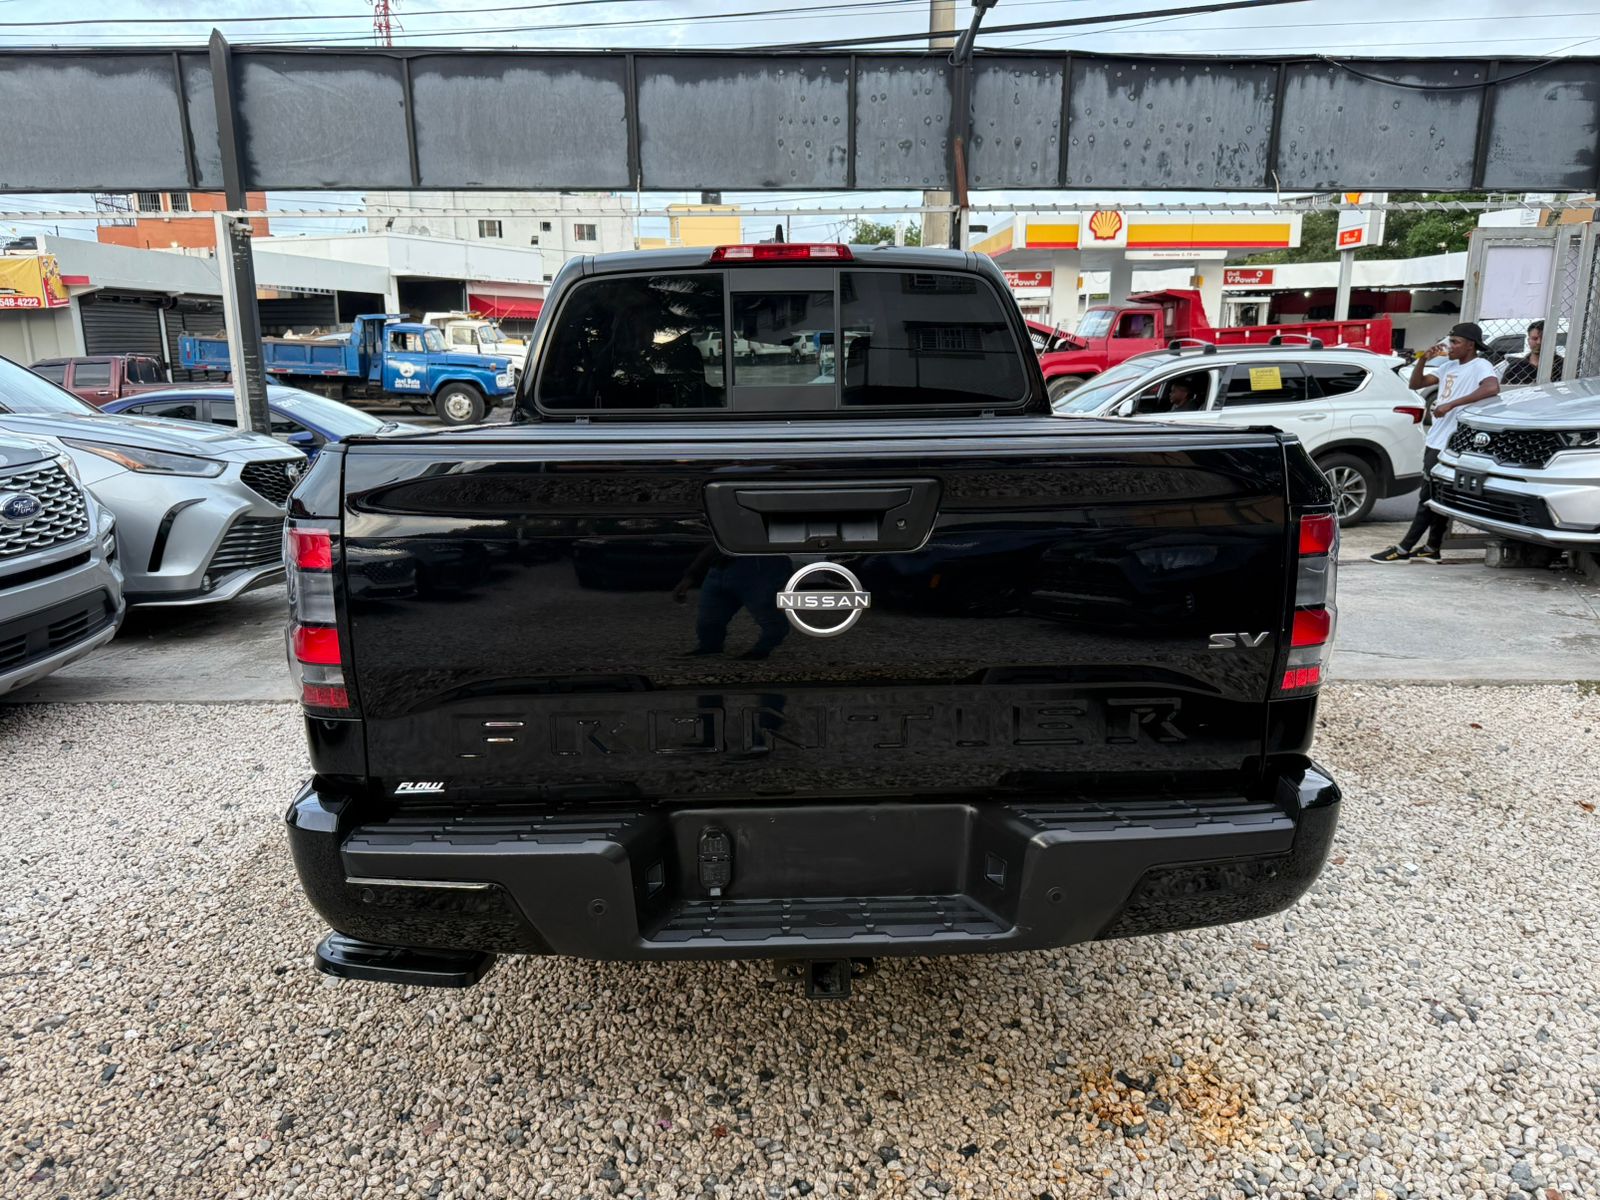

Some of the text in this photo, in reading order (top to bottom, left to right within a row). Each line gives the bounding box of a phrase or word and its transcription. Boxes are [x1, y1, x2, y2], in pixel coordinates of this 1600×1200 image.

[13, 500, 34, 514] Ford
[779, 595, 869, 608] NISSAN
[1208, 631, 1270, 649] SV
[452, 698, 1187, 757] FRONTIER
[396, 782, 444, 791] FLOW
